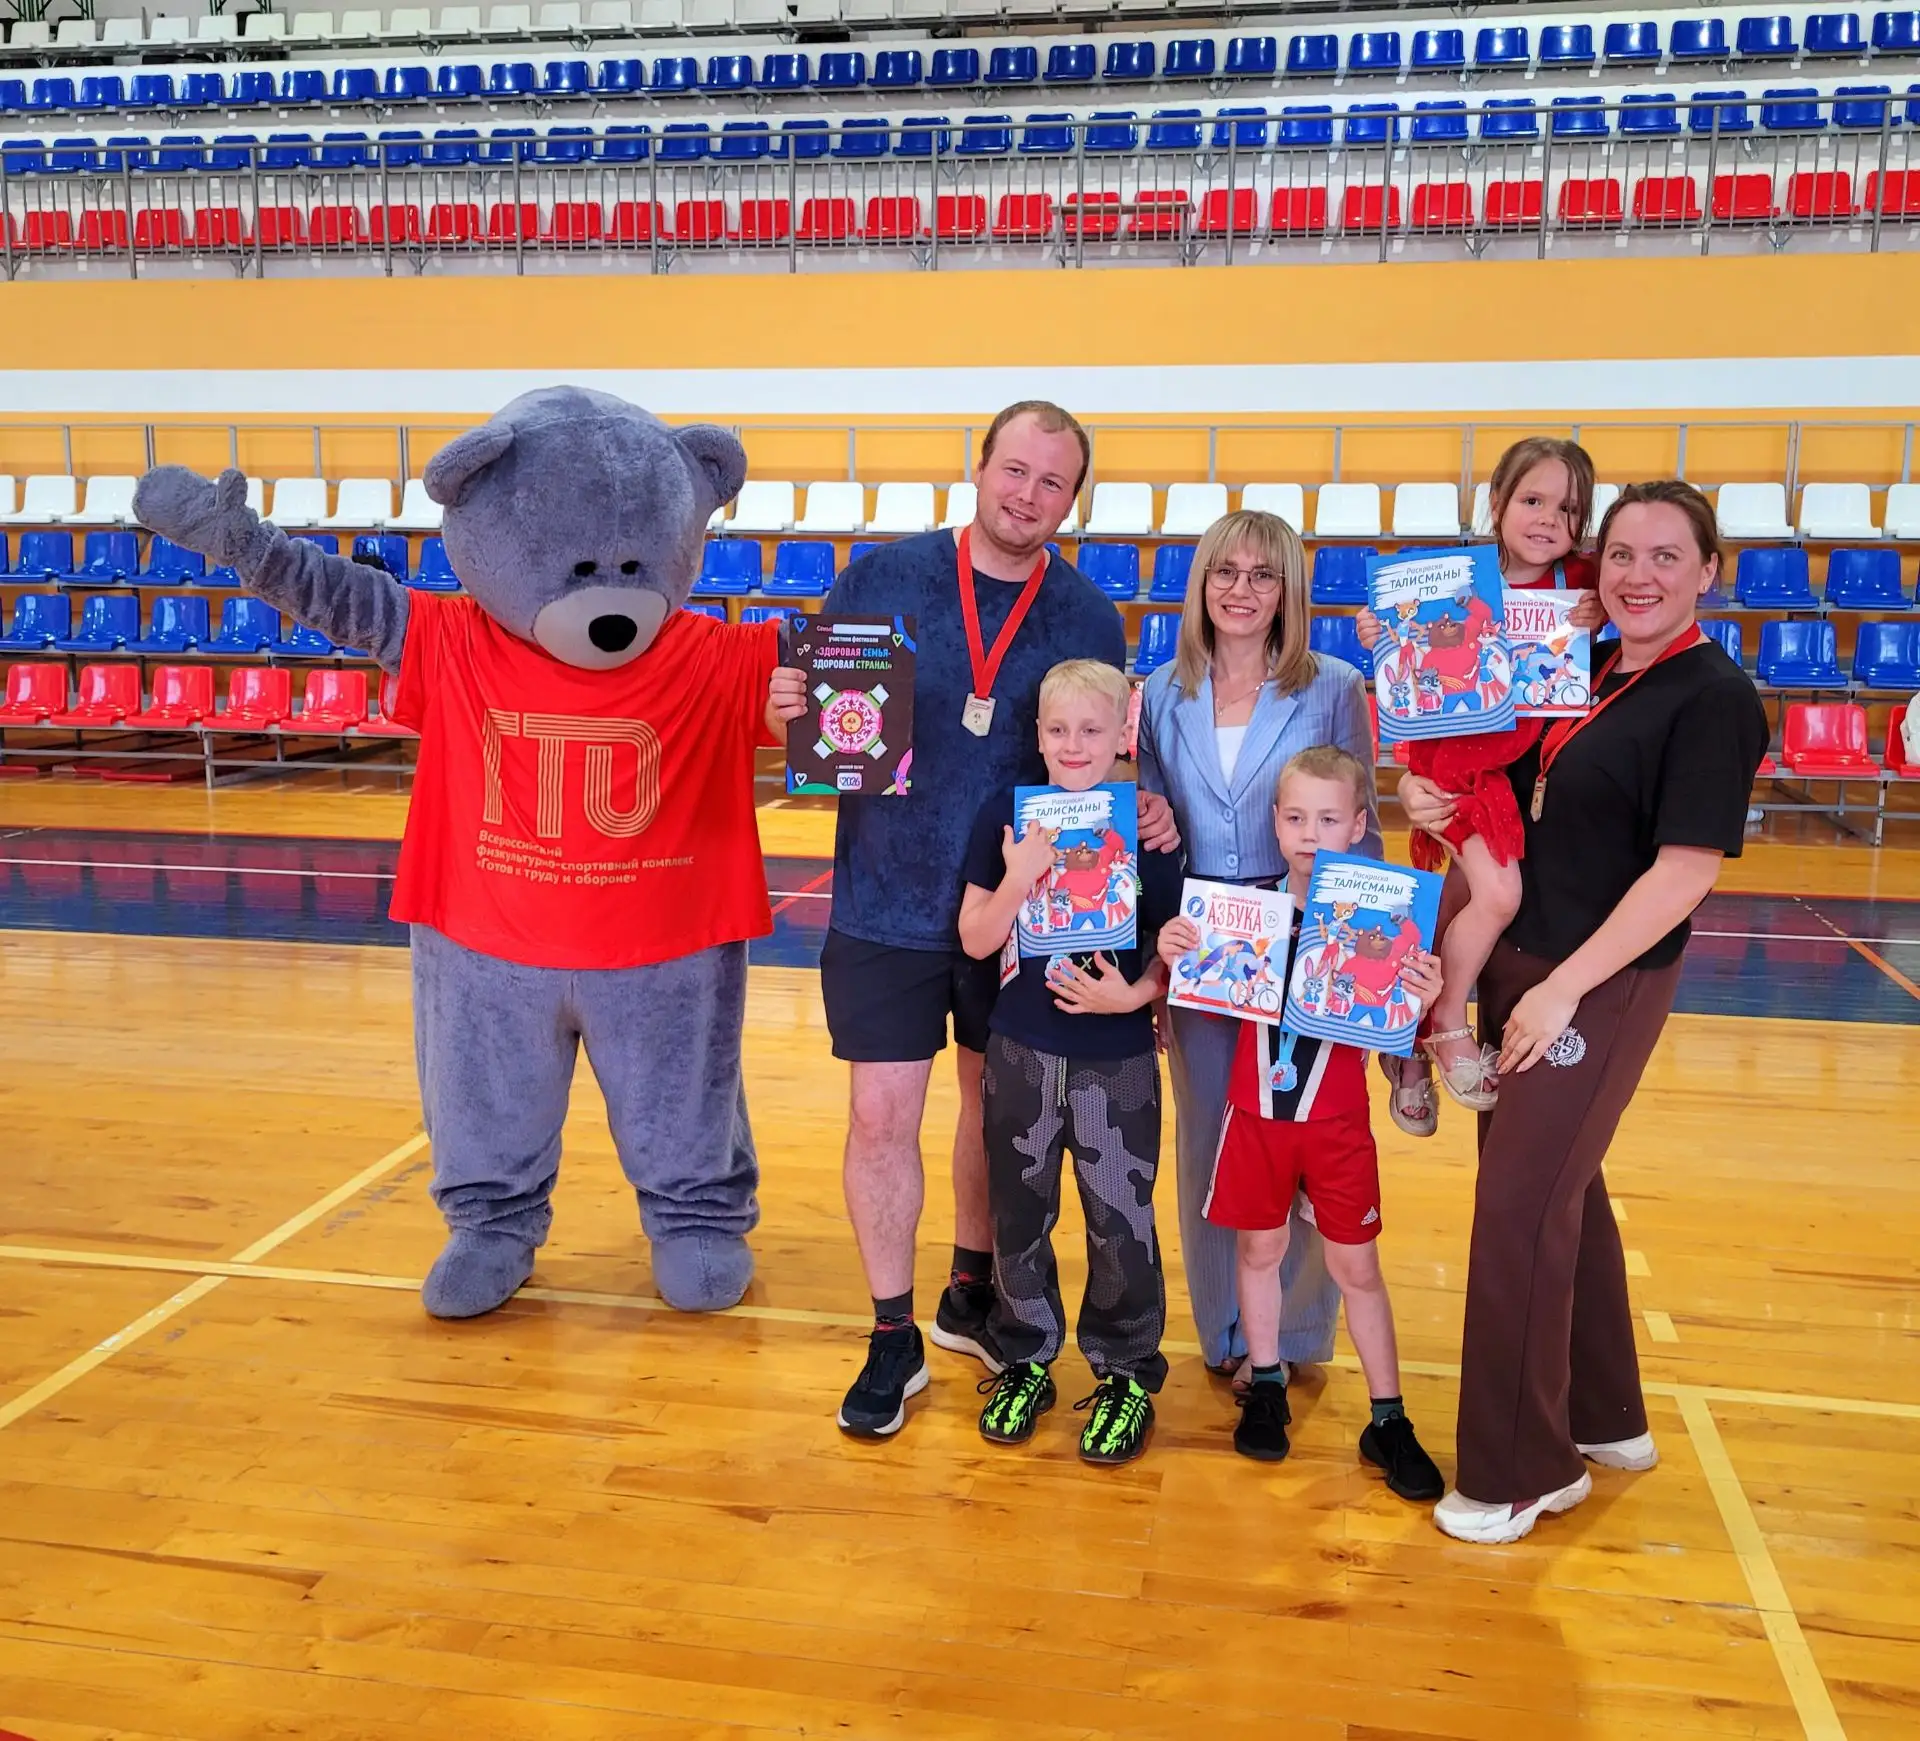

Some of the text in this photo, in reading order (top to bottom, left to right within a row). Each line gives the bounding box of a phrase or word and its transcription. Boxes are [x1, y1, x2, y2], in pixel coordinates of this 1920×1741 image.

[1390, 568, 1461, 589] ТАЛИСМАНЫ
[1419, 585, 1438, 597] ГТО
[1504, 607, 1556, 632] ЗБУКА
[815, 647, 861, 657] «ЗДОРОВАЯ
[812, 658, 855, 670] ЗДОРОВАЯ
[1036, 802, 1101, 817] ТАЛИСМАНЫ
[1061, 816, 1079, 825] ГТО
[479, 829, 562, 858] Всероссийский
[476, 844, 694, 873] физкультурно-спортивный комплекс
[477, 857, 637, 887] «Готов к труду и обороне»
[1333, 877, 1404, 896] ТАЛИСМАНЫ
[1358, 893, 1378, 904] ГТО
[1207, 901, 1261, 932] АЗБУКА
